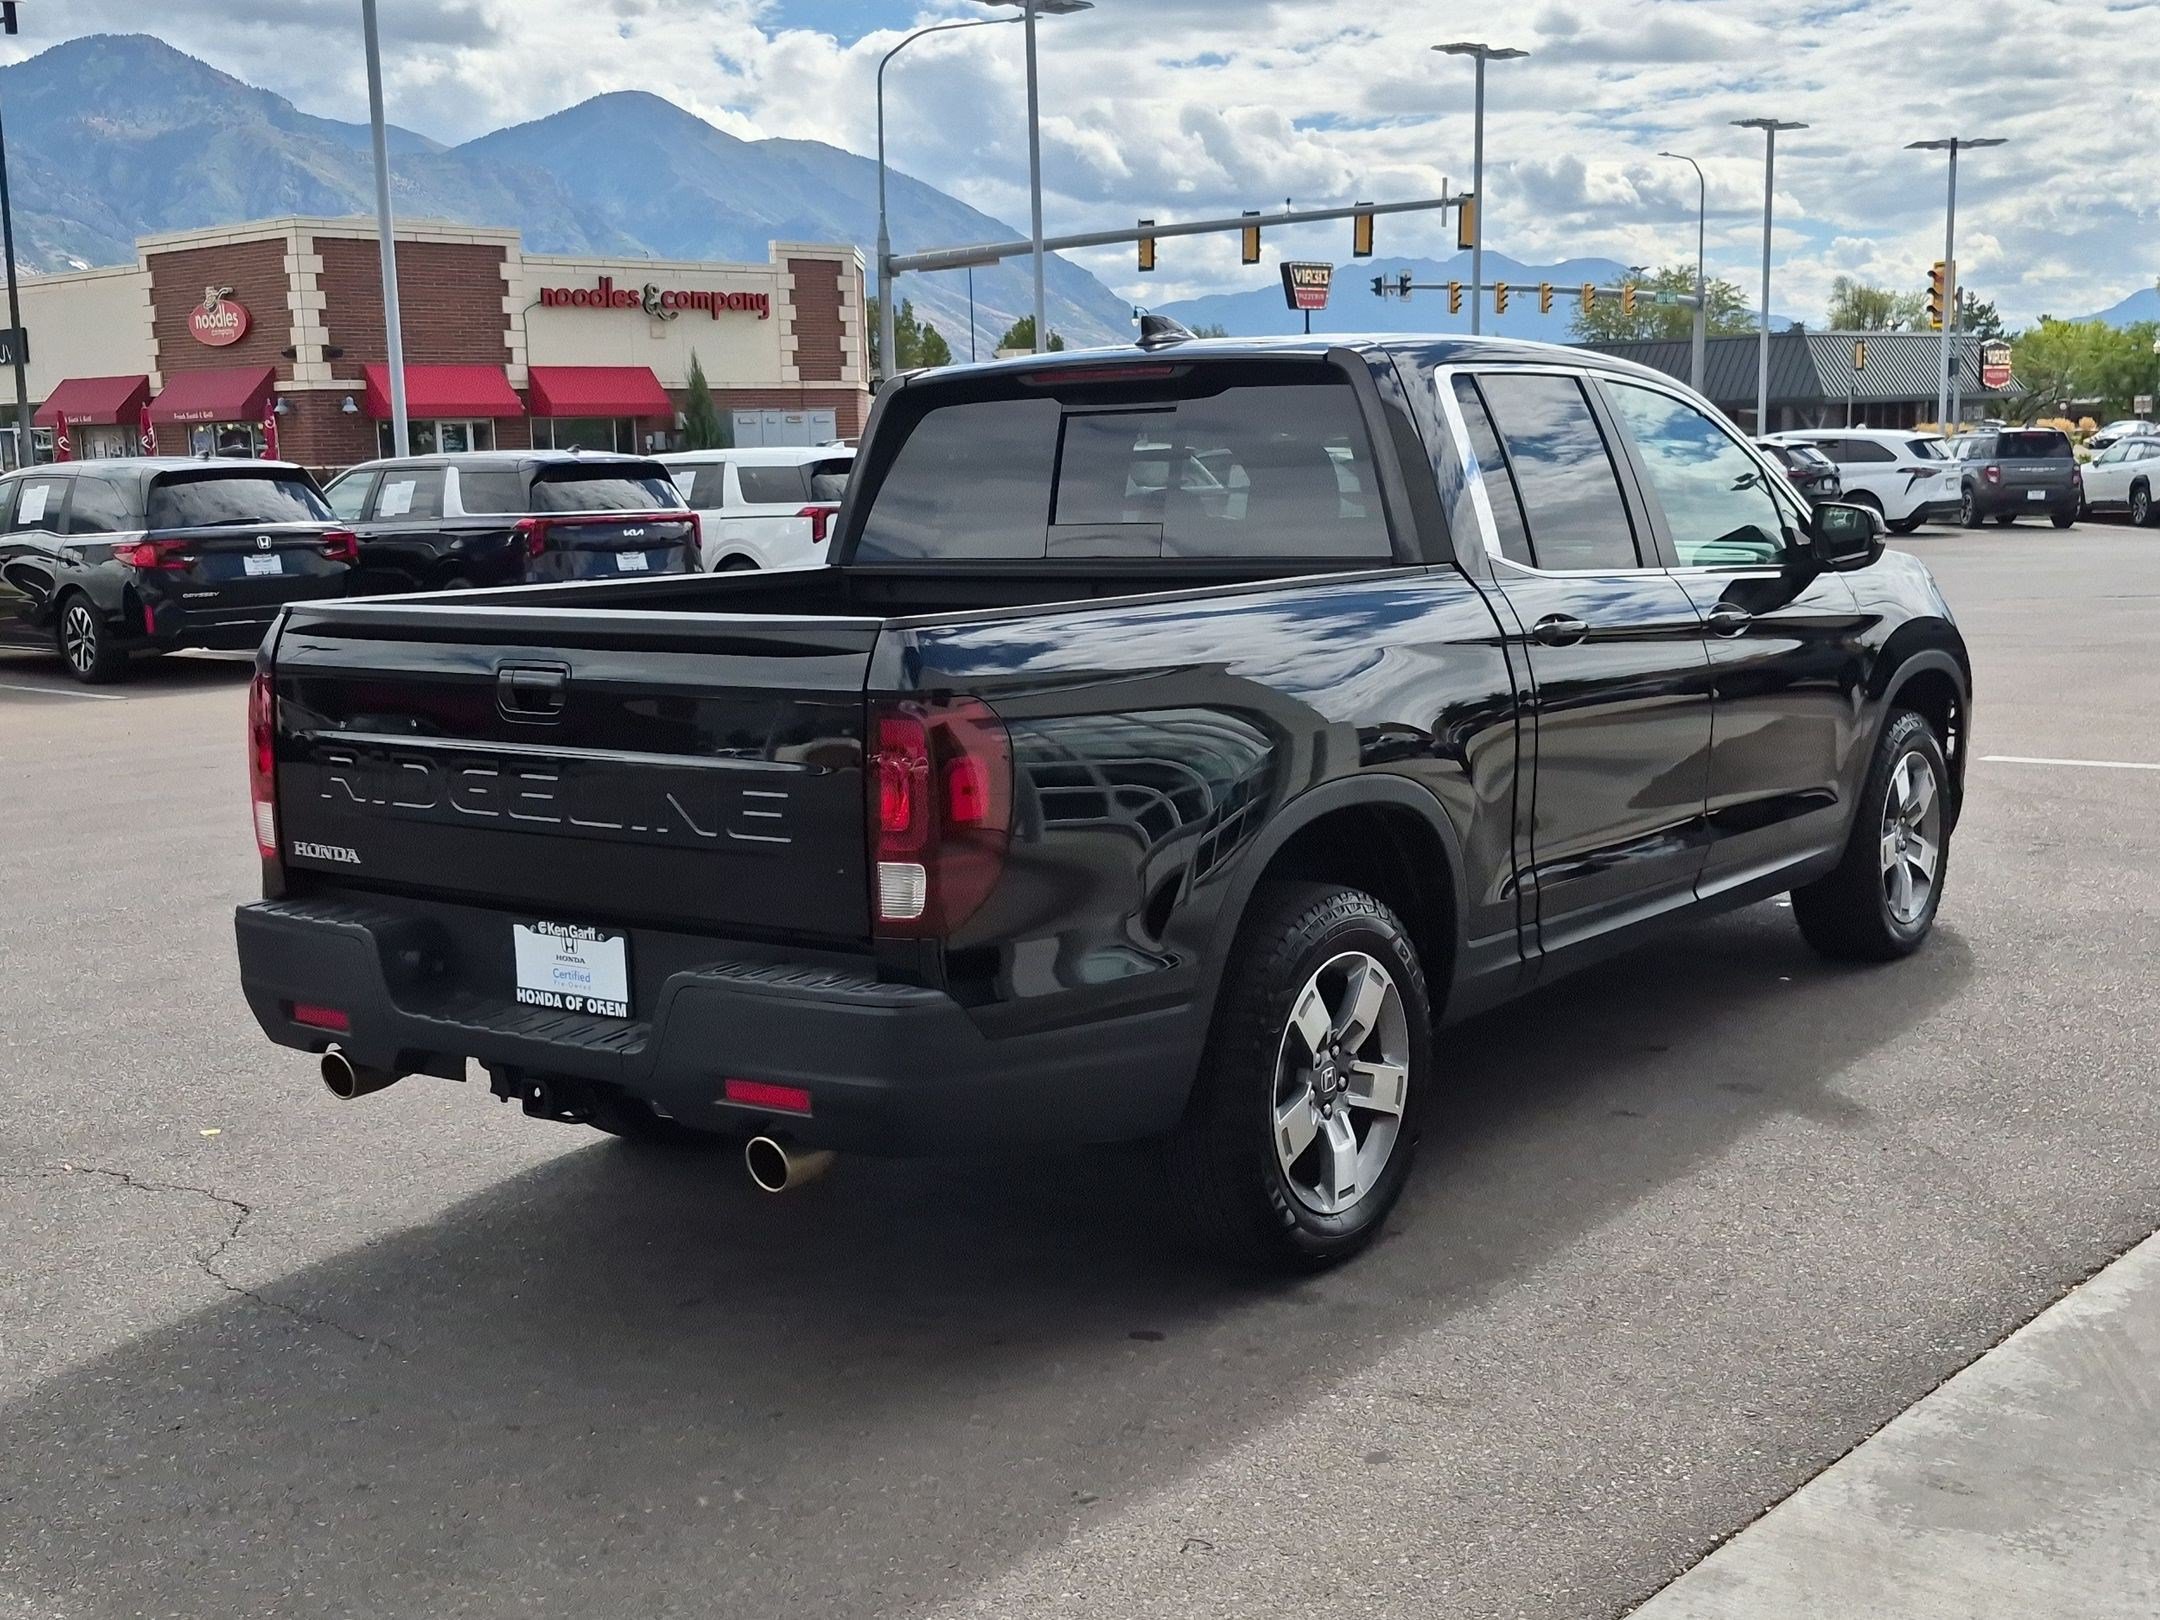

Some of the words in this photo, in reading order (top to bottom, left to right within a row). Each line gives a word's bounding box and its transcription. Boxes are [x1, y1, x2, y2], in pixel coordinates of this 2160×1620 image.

[541, 276, 641, 307] noodles
[642, 283, 679, 321] &
[661, 290, 770, 320] company
[195, 303, 239, 329] noodles
[317, 750, 792, 843] RIDGELINE
[293, 841, 361, 864] HONDA
[556, 954, 586, 965] HONDA
[552, 967, 591, 983] Certified
[516, 988, 562, 1008] HONDA
[565, 995, 584, 1011] OF
[586, 999, 627, 1018] OREM
